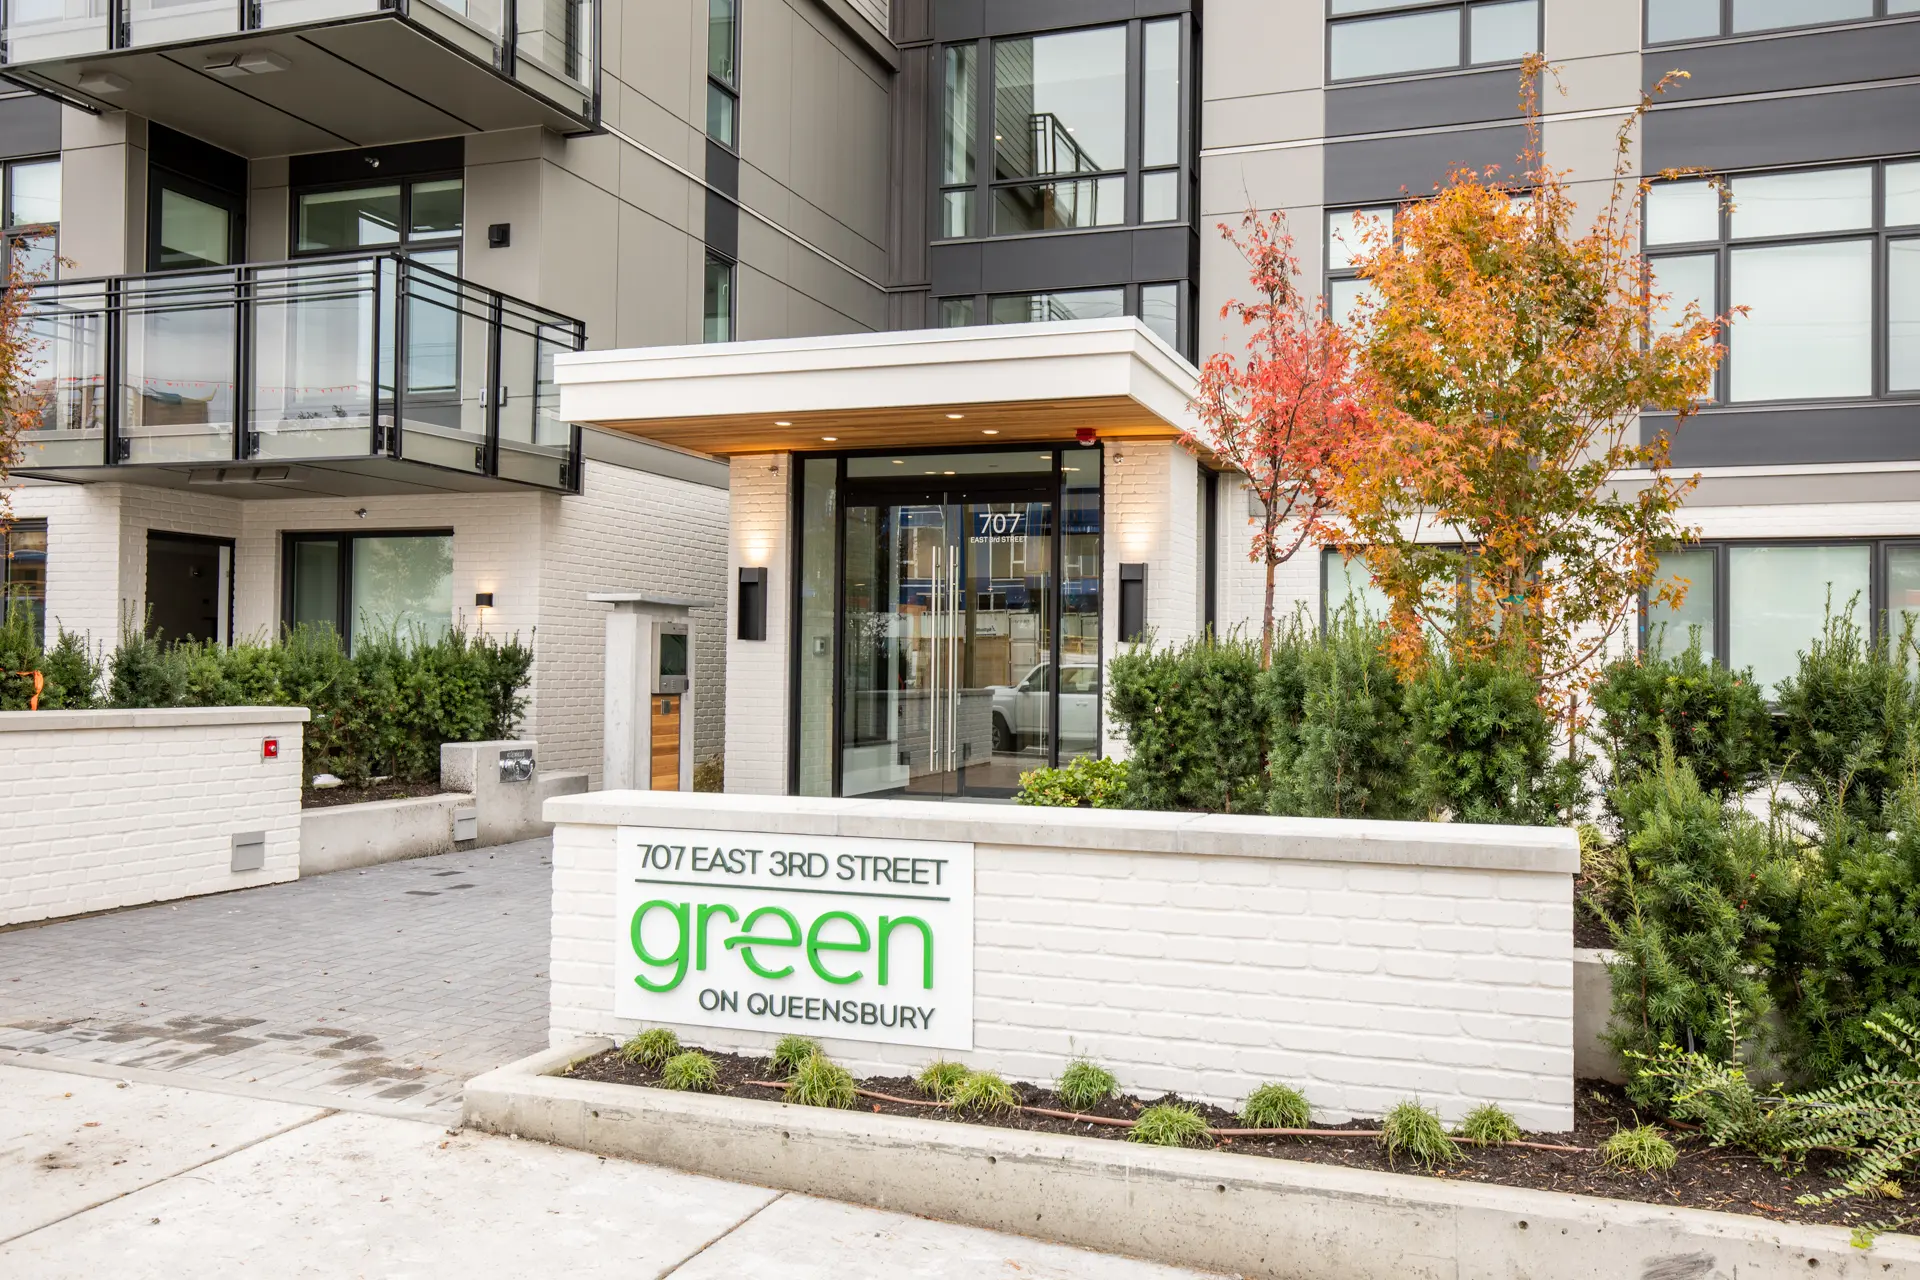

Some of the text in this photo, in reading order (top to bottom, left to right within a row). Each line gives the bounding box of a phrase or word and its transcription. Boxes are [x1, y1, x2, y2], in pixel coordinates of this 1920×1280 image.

[970, 536, 988, 544] EAST
[1001, 535, 1028, 543] STREET
[979, 513, 1021, 534] 707
[637, 843, 949, 886] 707 EAST 3RD STREET
[630, 899, 934, 993] green
[698, 988, 936, 1030] ON QUEENSBURY
